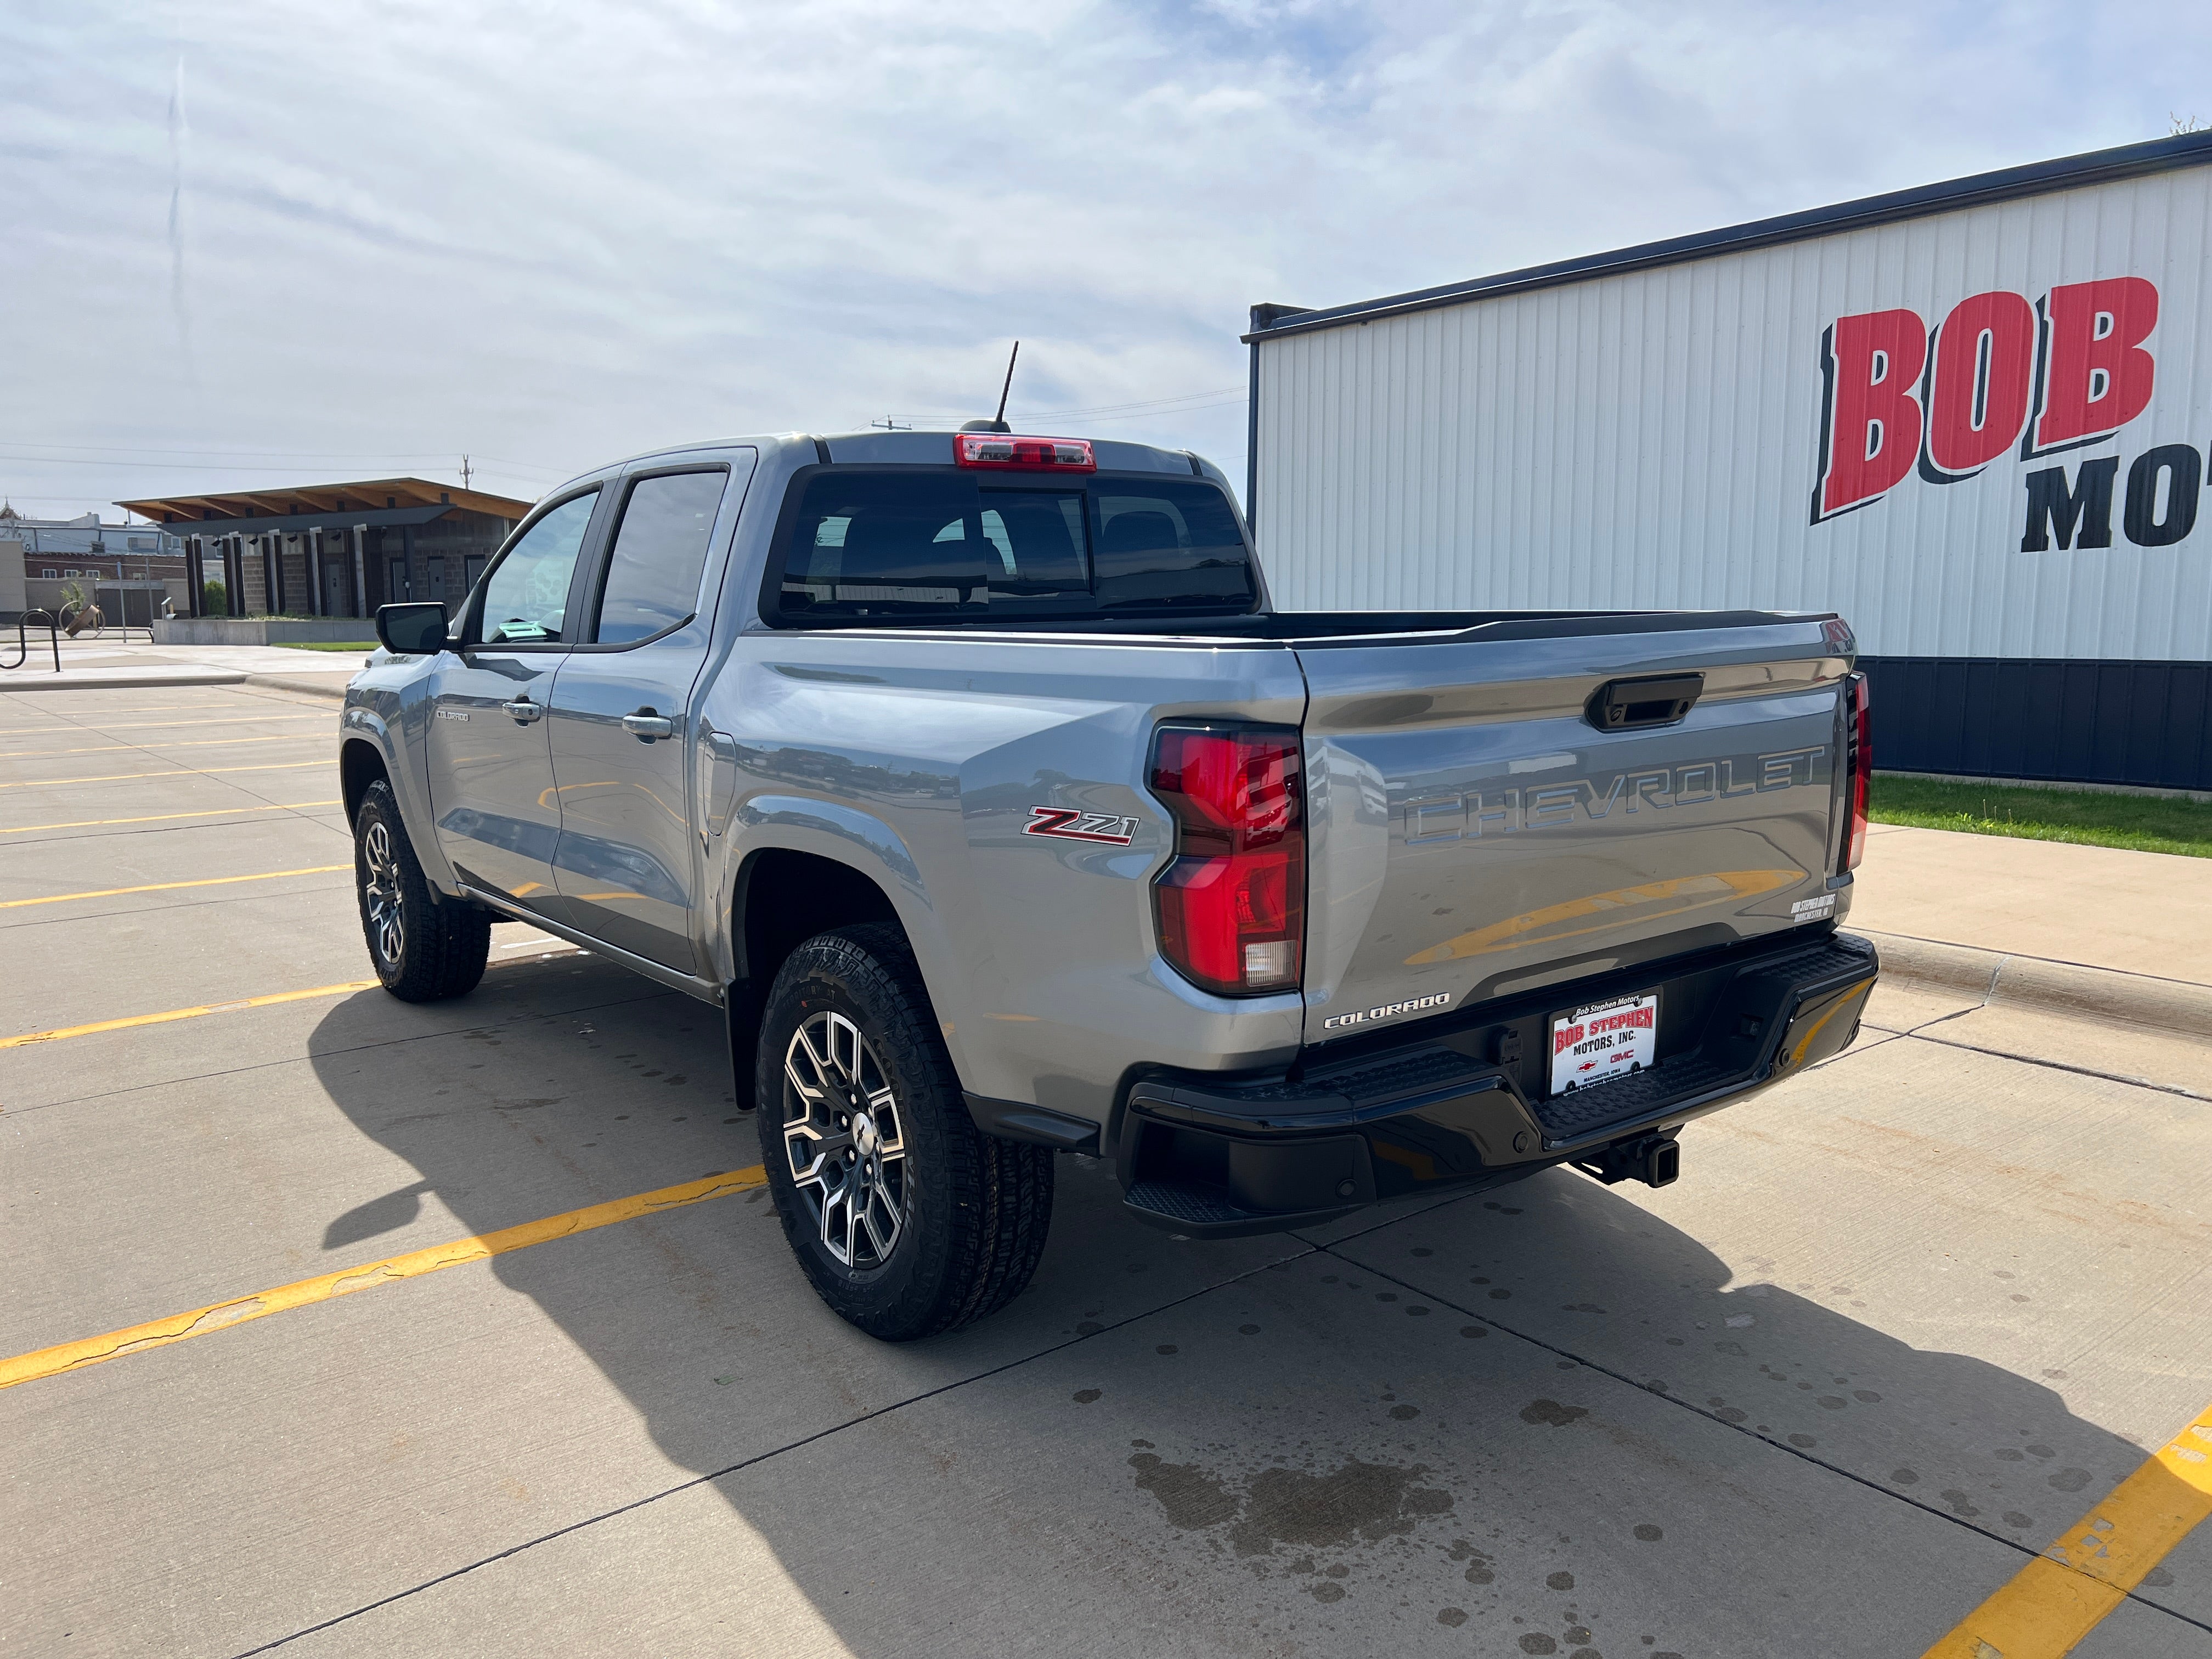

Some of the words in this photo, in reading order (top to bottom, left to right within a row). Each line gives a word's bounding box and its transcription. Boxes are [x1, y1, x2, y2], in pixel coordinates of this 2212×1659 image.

[1810, 276, 2159, 526] BOB
[2021, 441, 2212, 552] MO
[437, 710, 470, 722] COLORADO
[1404, 746, 1825, 845] CHEVROLET
[1020, 805, 1141, 847] Z71
[1323, 991, 1451, 1030] COLORADO
[1576, 1008, 1589, 1016] Bob
[1589, 1001, 1617, 1013] Stephen
[1617, 995, 1640, 1006] Motors
[1554, 1024, 1584, 1056] BOB
[1589, 1005, 1654, 1036] STEPHEN
[1573, 1035, 1615, 1056] MOTORS,
[1618, 1030, 1636, 1045] INC.
[1610, 1048, 1634, 1064] GMC
